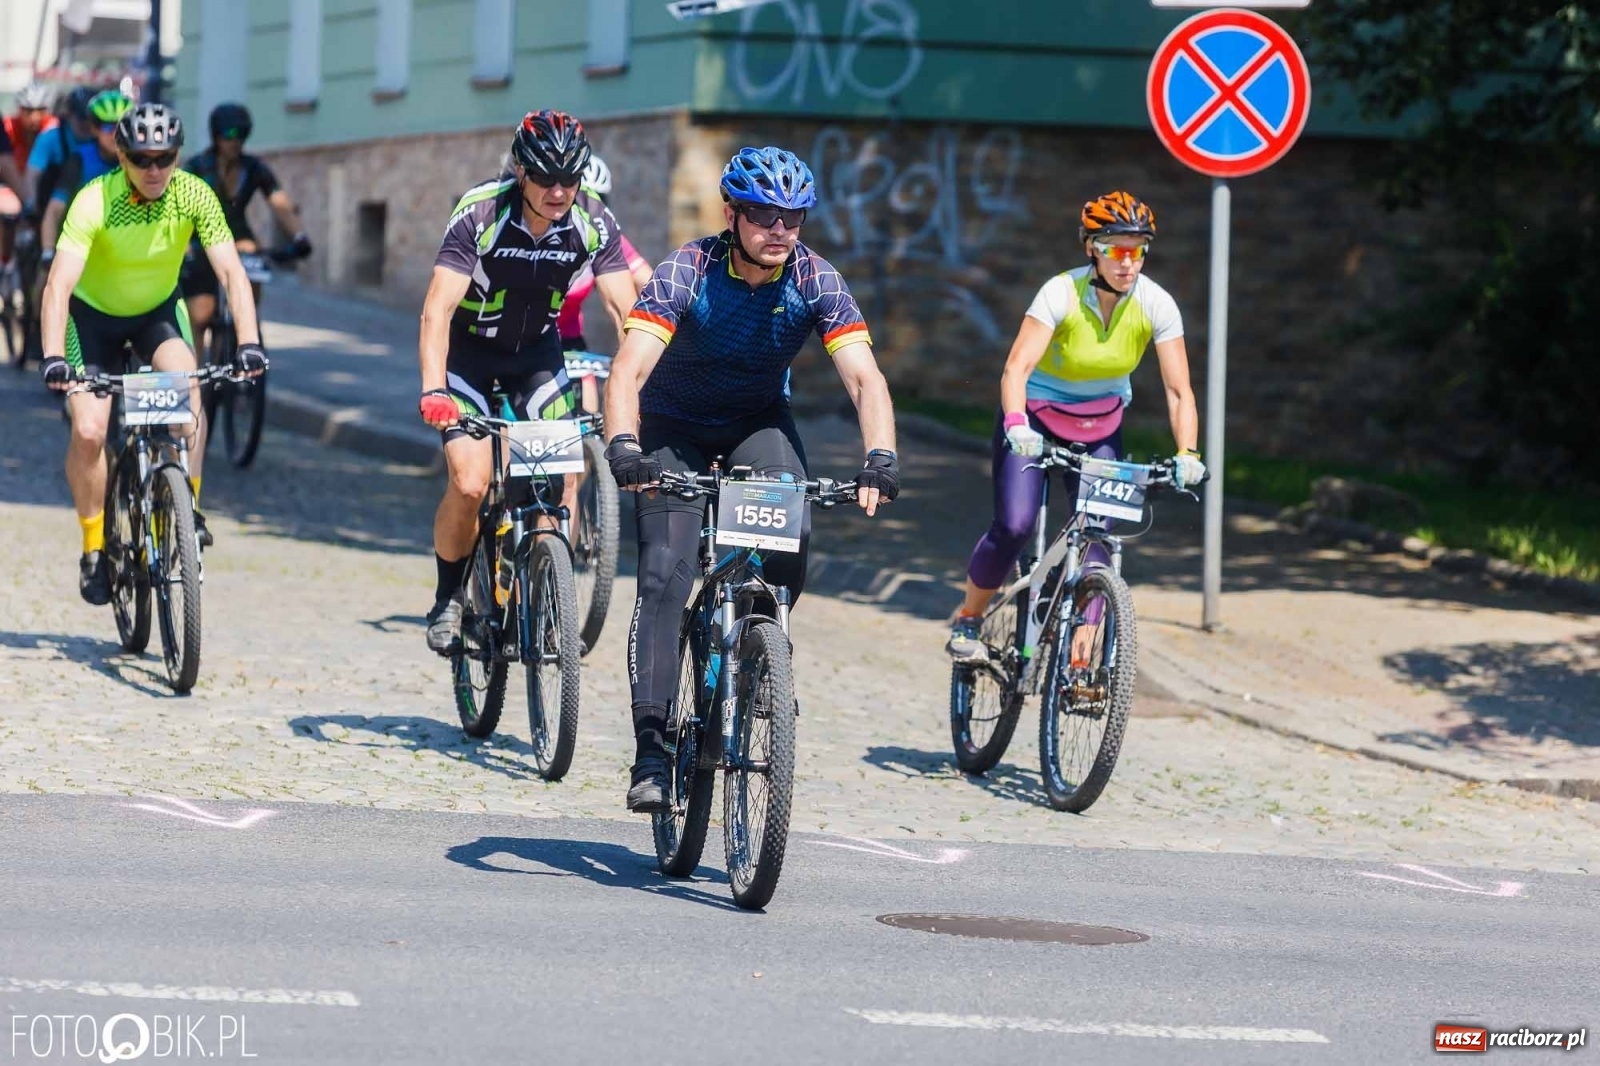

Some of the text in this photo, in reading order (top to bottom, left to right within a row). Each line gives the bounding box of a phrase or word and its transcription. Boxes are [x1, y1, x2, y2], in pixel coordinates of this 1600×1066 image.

[493, 247, 578, 263] MERIDA
[1090, 479, 1136, 501] 1447
[734, 504, 787, 529] 1555
[629, 596, 643, 686] ROCKBROS
